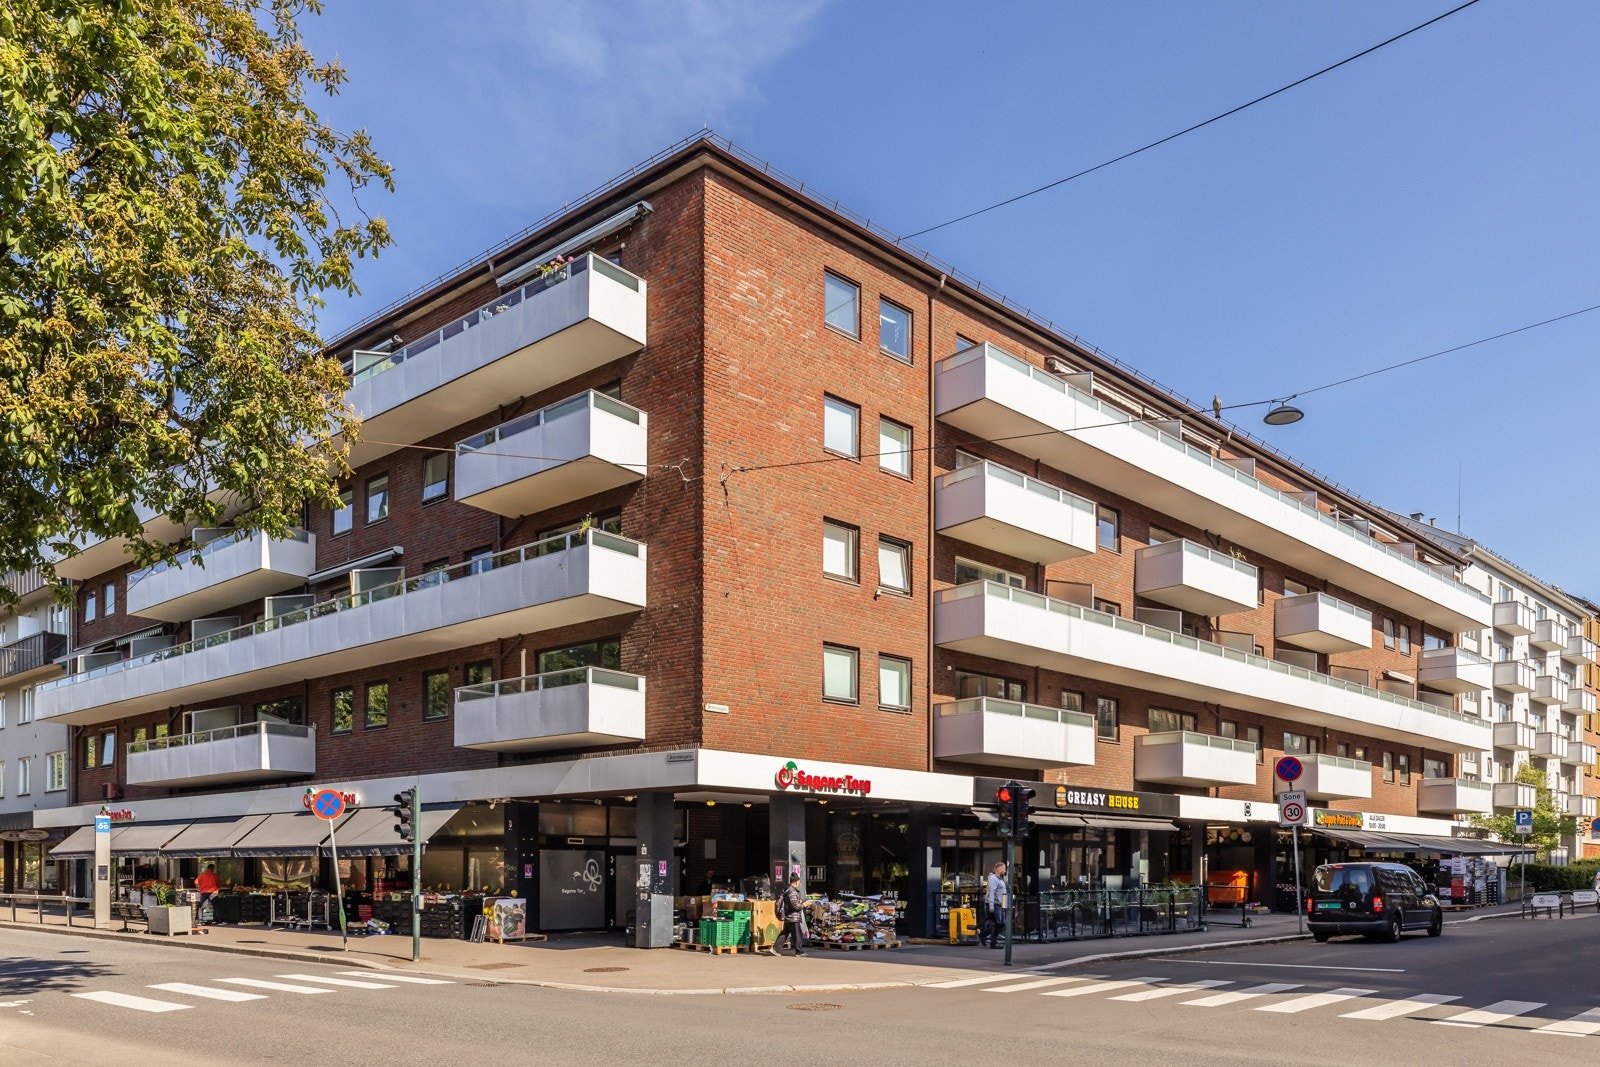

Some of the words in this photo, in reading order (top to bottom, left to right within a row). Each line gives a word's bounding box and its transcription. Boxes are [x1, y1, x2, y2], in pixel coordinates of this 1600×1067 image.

[797, 770, 843, 790] Sagene
[845, 775, 871, 794] Torg
[1067, 790, 1105, 806] GREASY
[1108, 794, 1139, 809] HOUSE
[1283, 793, 1301, 801] Sone
[1287, 807, 1300, 817] 30
[1519, 813, 1528, 824] P
[882, 890, 899, 899] THE
